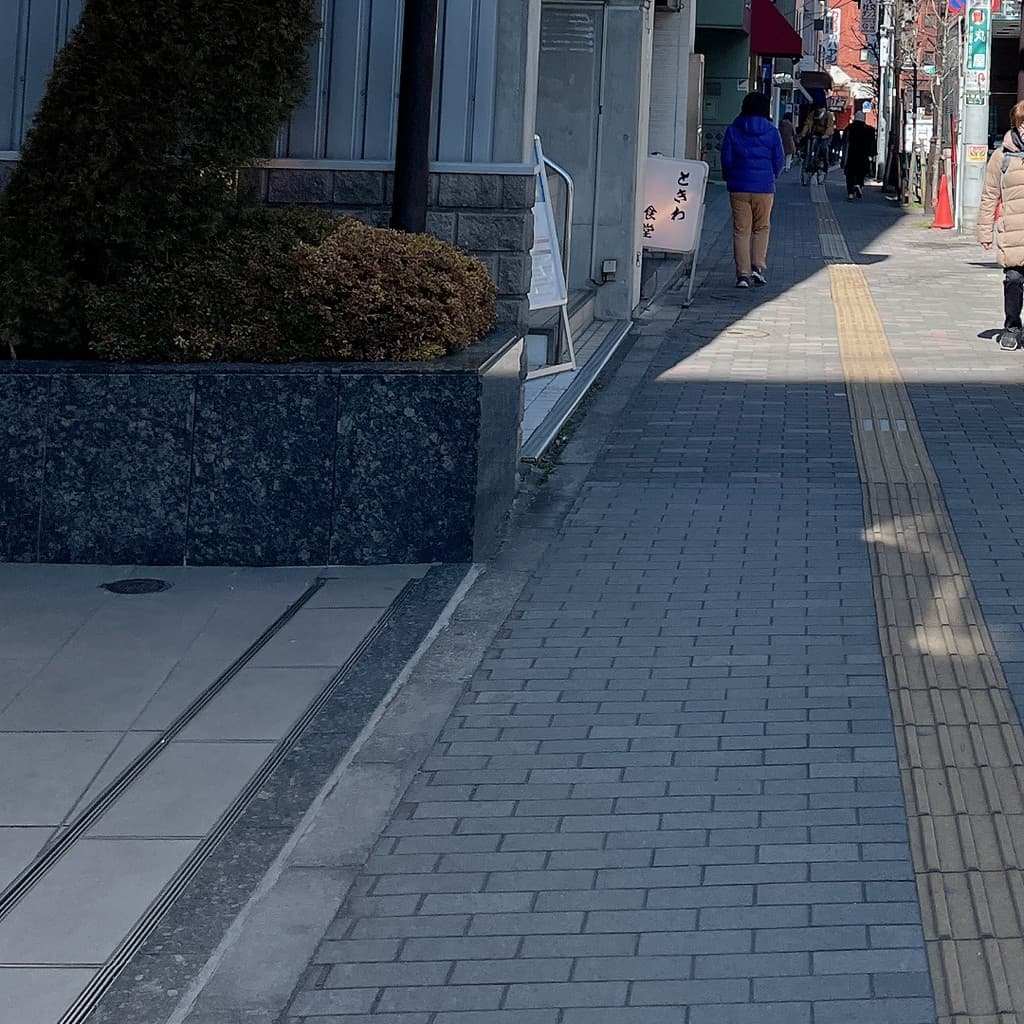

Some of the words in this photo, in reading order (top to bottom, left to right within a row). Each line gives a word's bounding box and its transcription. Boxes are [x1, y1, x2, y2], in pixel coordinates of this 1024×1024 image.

[671, 171, 690, 221] ときわ
[643, 205, 658, 238] 食堂
